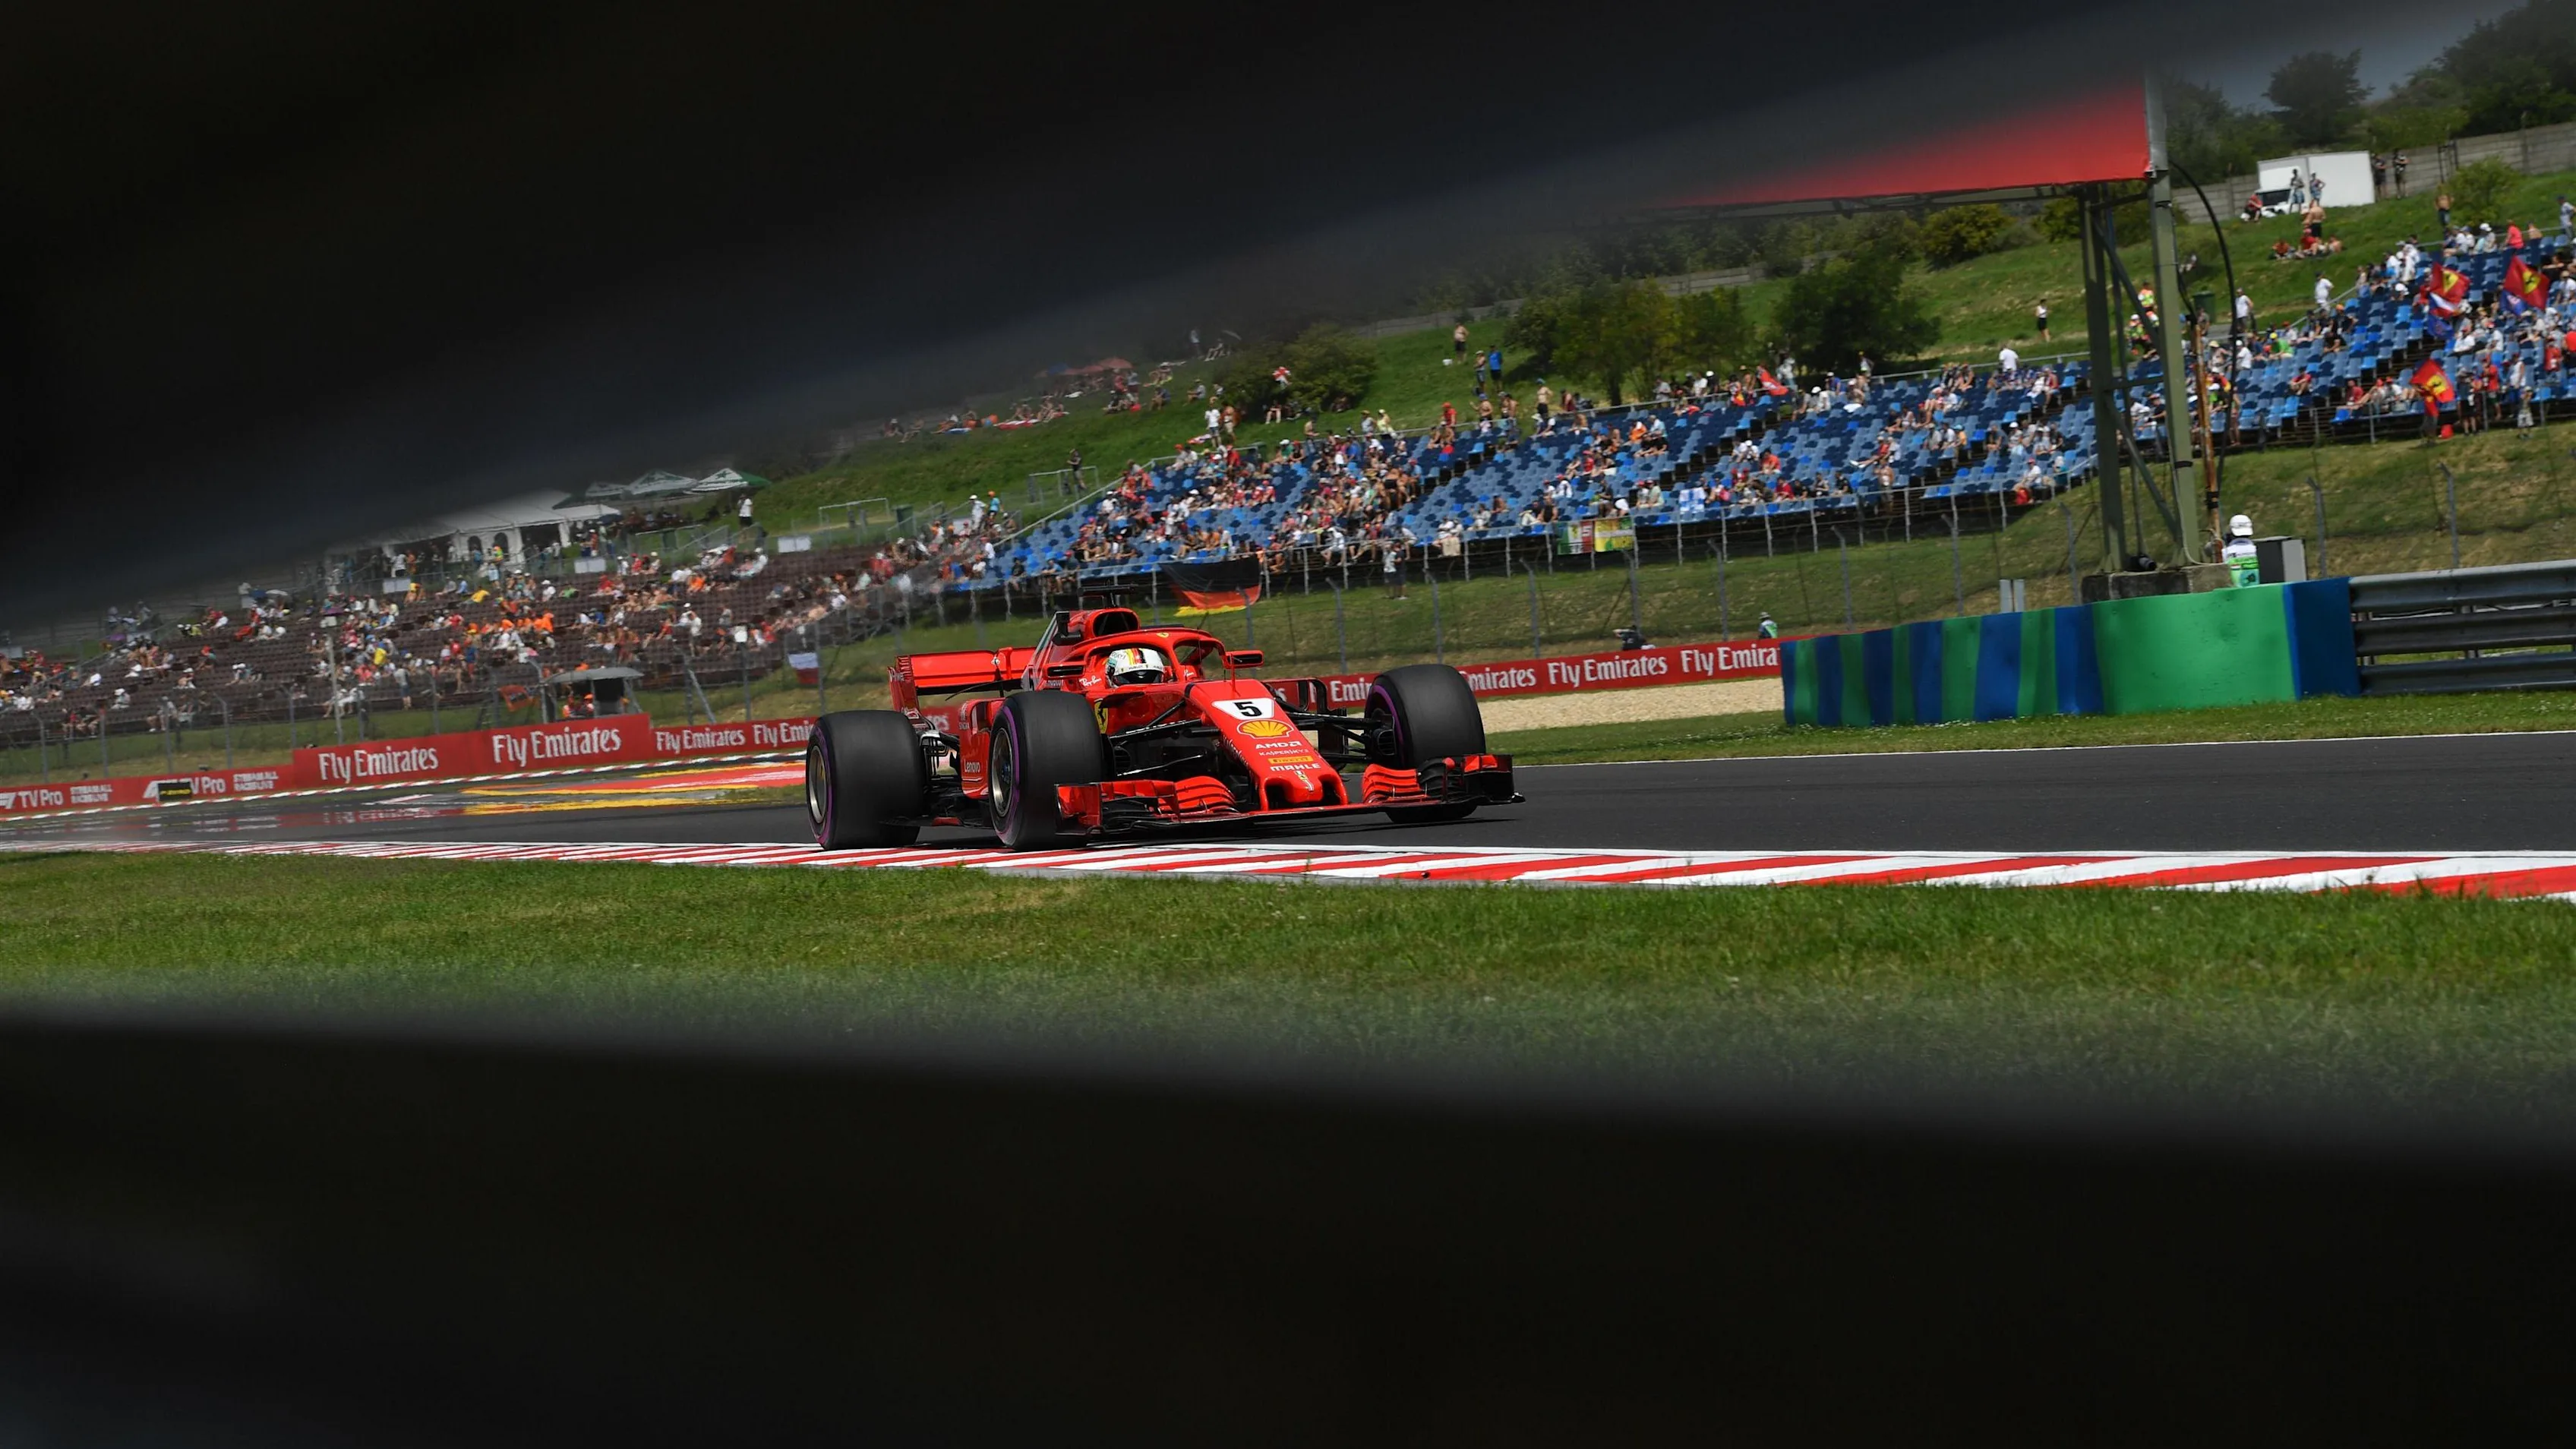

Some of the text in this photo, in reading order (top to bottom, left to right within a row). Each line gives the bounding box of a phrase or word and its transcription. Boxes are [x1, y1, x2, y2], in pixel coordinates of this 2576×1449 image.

[1547, 655, 1668, 687] Fly Emirates
[1680, 643, 1779, 676] Fly Emira
[1233, 701, 1261, 717] 5
[492, 727, 621, 767] Fly Emirates
[655, 727, 746, 754] Fly Emirates
[752, 724, 778, 747] Fly
[318, 746, 438, 784] Fly Emirates
[964, 762, 980, 773] Lenovo
[1270, 762, 1321, 772] MAHLE
[200, 776, 226, 794] Pro
[18, 790, 38, 808] TV
[39, 788, 63, 806] Pro
